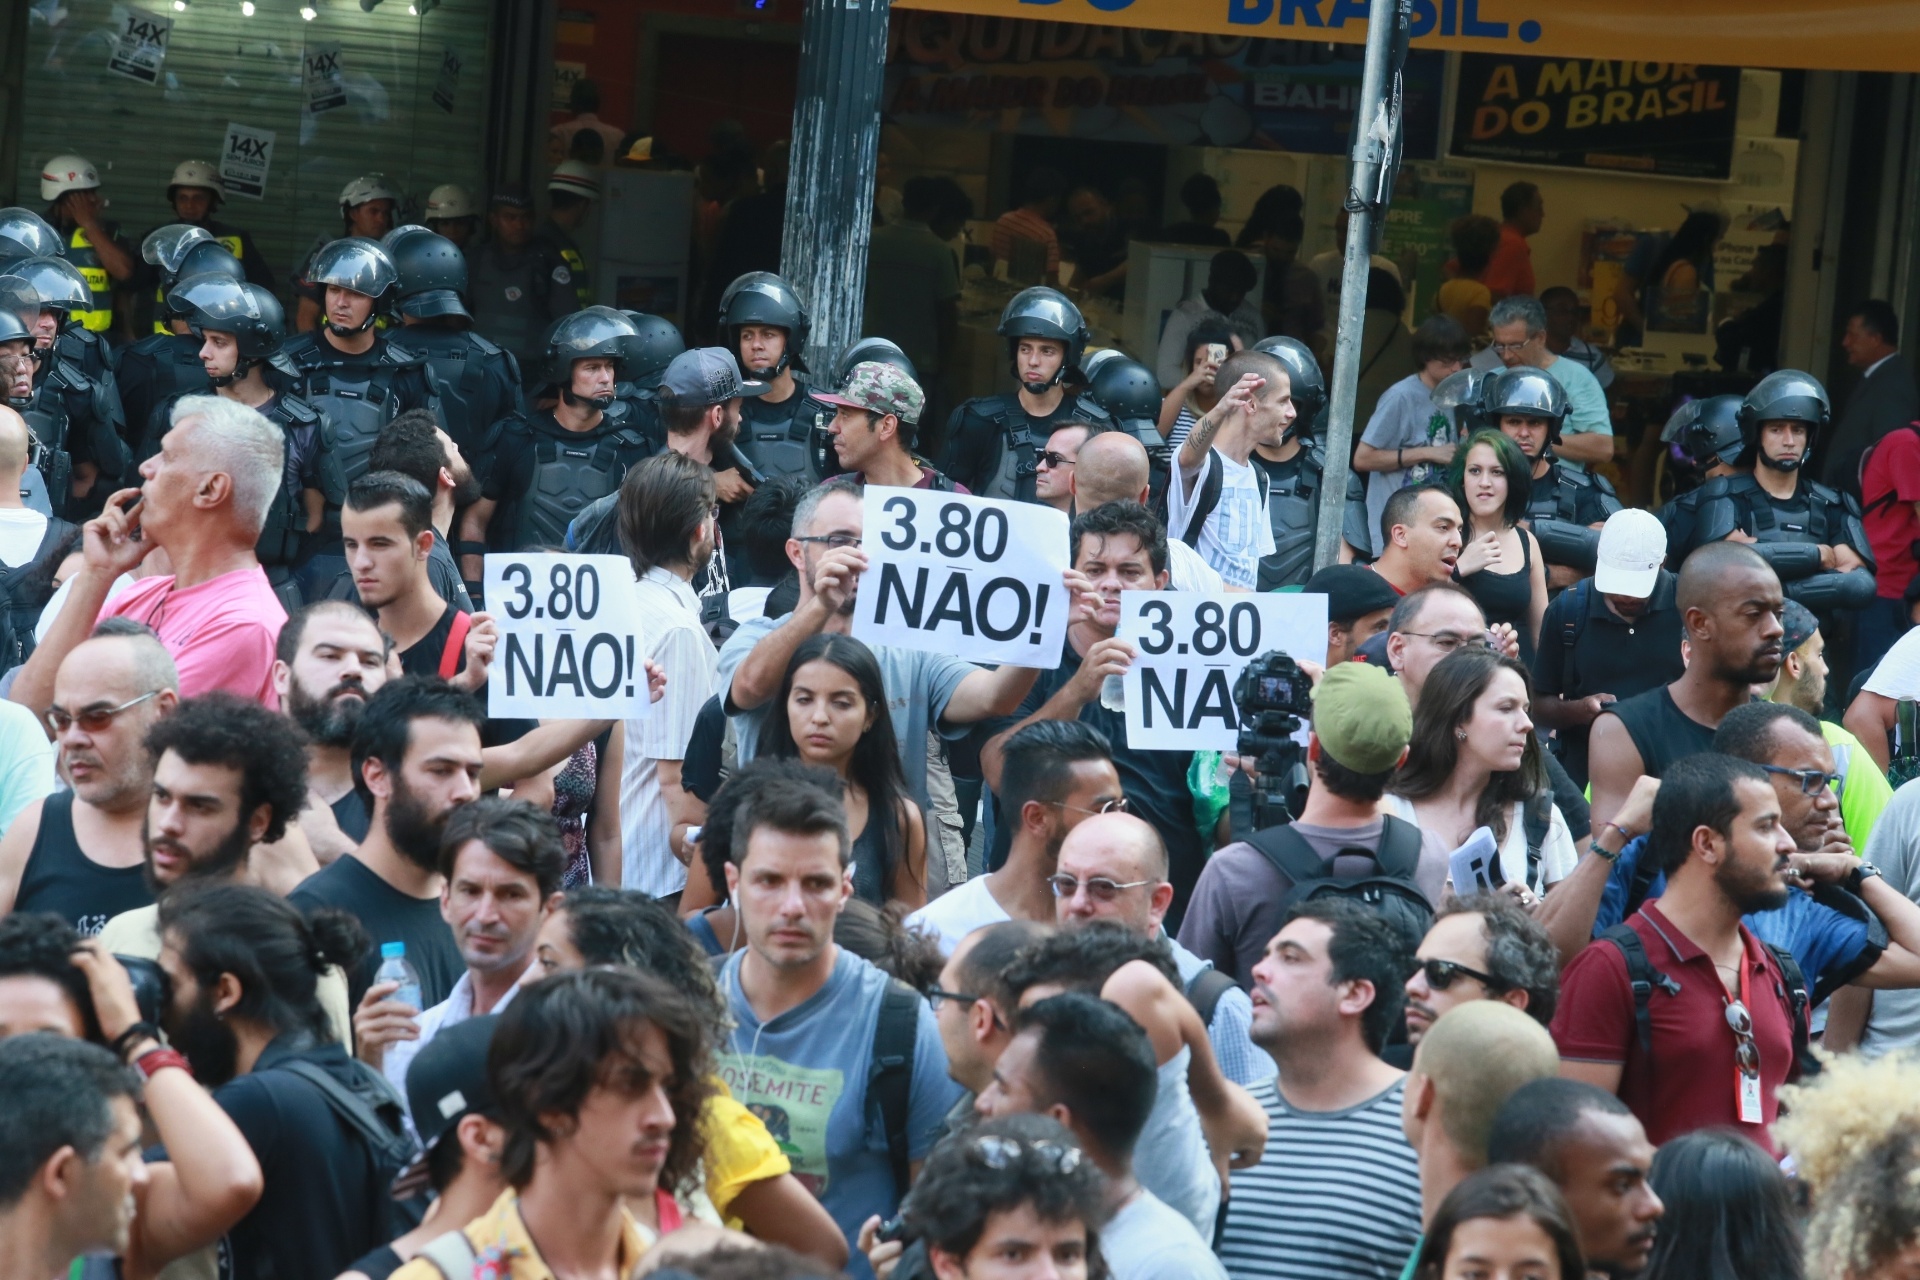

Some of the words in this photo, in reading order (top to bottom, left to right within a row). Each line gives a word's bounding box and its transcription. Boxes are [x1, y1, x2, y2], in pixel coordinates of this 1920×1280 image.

[127, 17, 167, 45] 14X
[306, 52, 339, 75] 14X
[1482, 64, 1520, 101] A
[1535, 60, 1702, 97] MAIOR
[1254, 83, 1362, 110] BAHI
[1471, 101, 1551, 140] DO
[1565, 80, 1727, 129] BRASIL
[230, 134, 269, 160] 14X
[881, 496, 1008, 563] 3.80
[1209, 547, 1257, 586] URBA
[502, 563, 599, 620] 3.80
[1139, 600, 1261, 656] 3.80
[720, 1066, 828, 1106] OSEMITE
